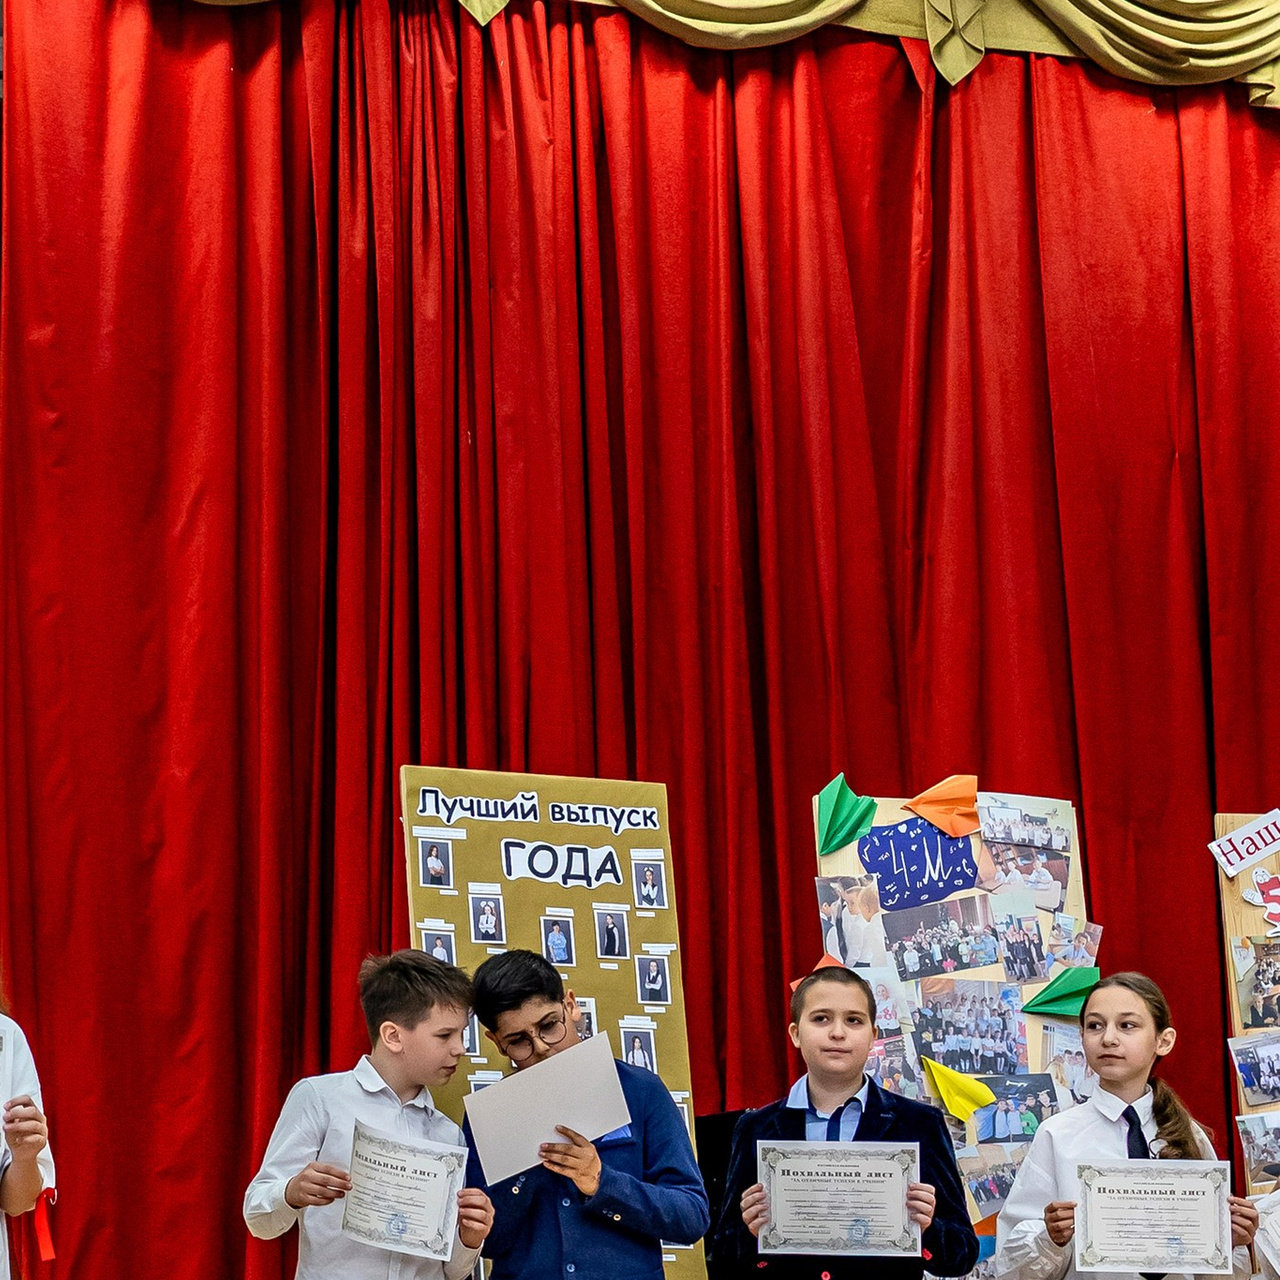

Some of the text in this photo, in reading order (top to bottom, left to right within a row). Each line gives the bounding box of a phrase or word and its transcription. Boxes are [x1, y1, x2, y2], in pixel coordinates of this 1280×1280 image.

[419, 788, 658, 834] Лучший выпуск
[504, 841, 621, 887] ГОДА
